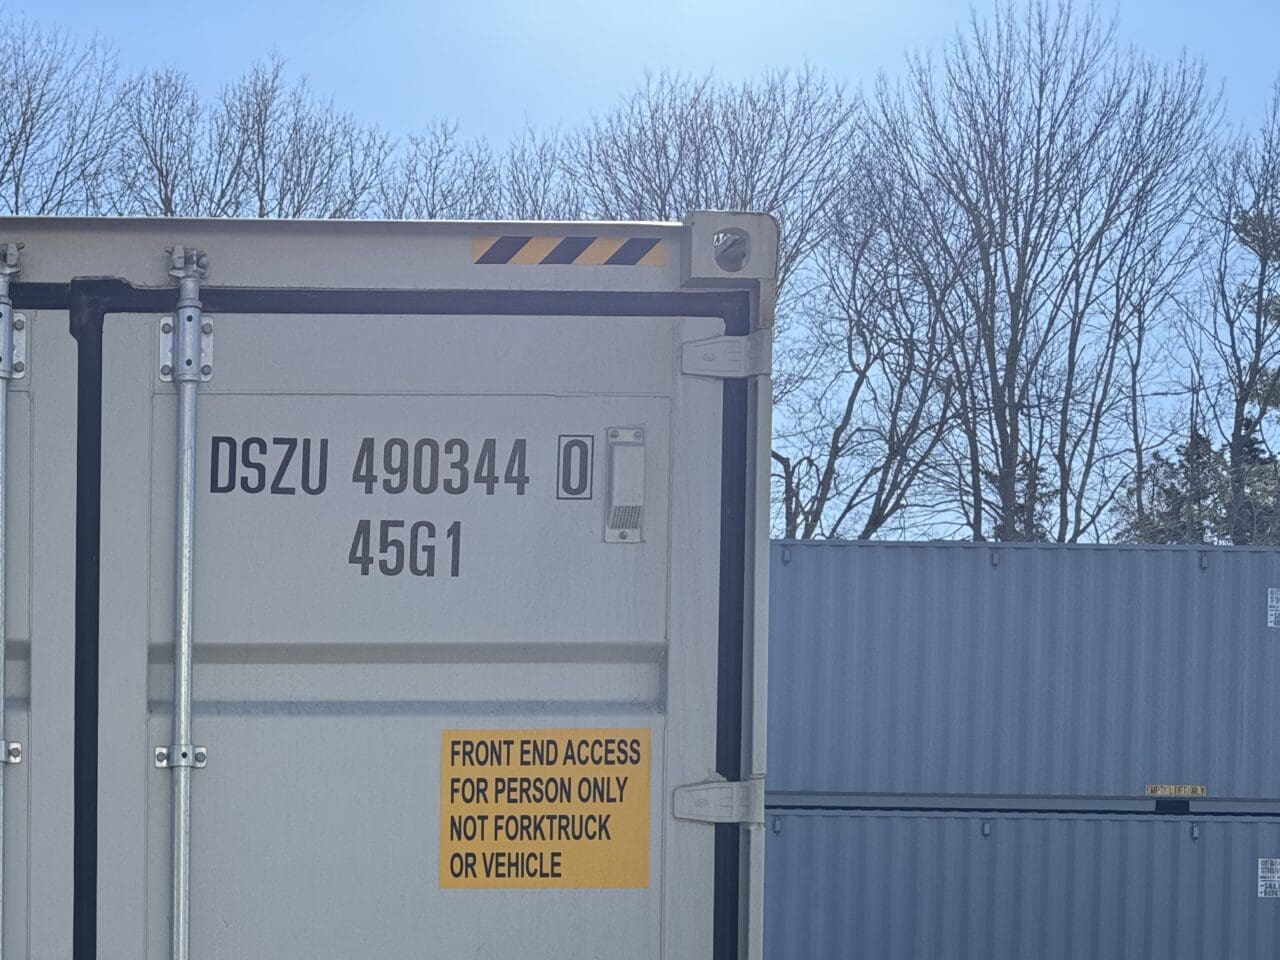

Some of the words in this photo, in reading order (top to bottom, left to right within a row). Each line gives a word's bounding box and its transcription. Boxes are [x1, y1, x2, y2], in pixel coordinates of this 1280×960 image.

[209, 435, 329, 496] DSZU
[352, 437, 531, 496] 490344
[561, 438, 590, 496] 0
[348, 520, 462, 577] 45G1
[450, 740, 514, 767] FRONT
[520, 740, 558, 766] END
[562, 739, 641, 766] ACCESS
[450, 778, 489, 804] FOR
[494, 777, 572, 804] PERSON
[577, 776, 629, 803] ONLY
[450, 815, 488, 841] NOT
[494, 814, 611, 841] FORKTRUCK
[450, 852, 477, 878] OR
[482, 852, 562, 878] VEHICLE
